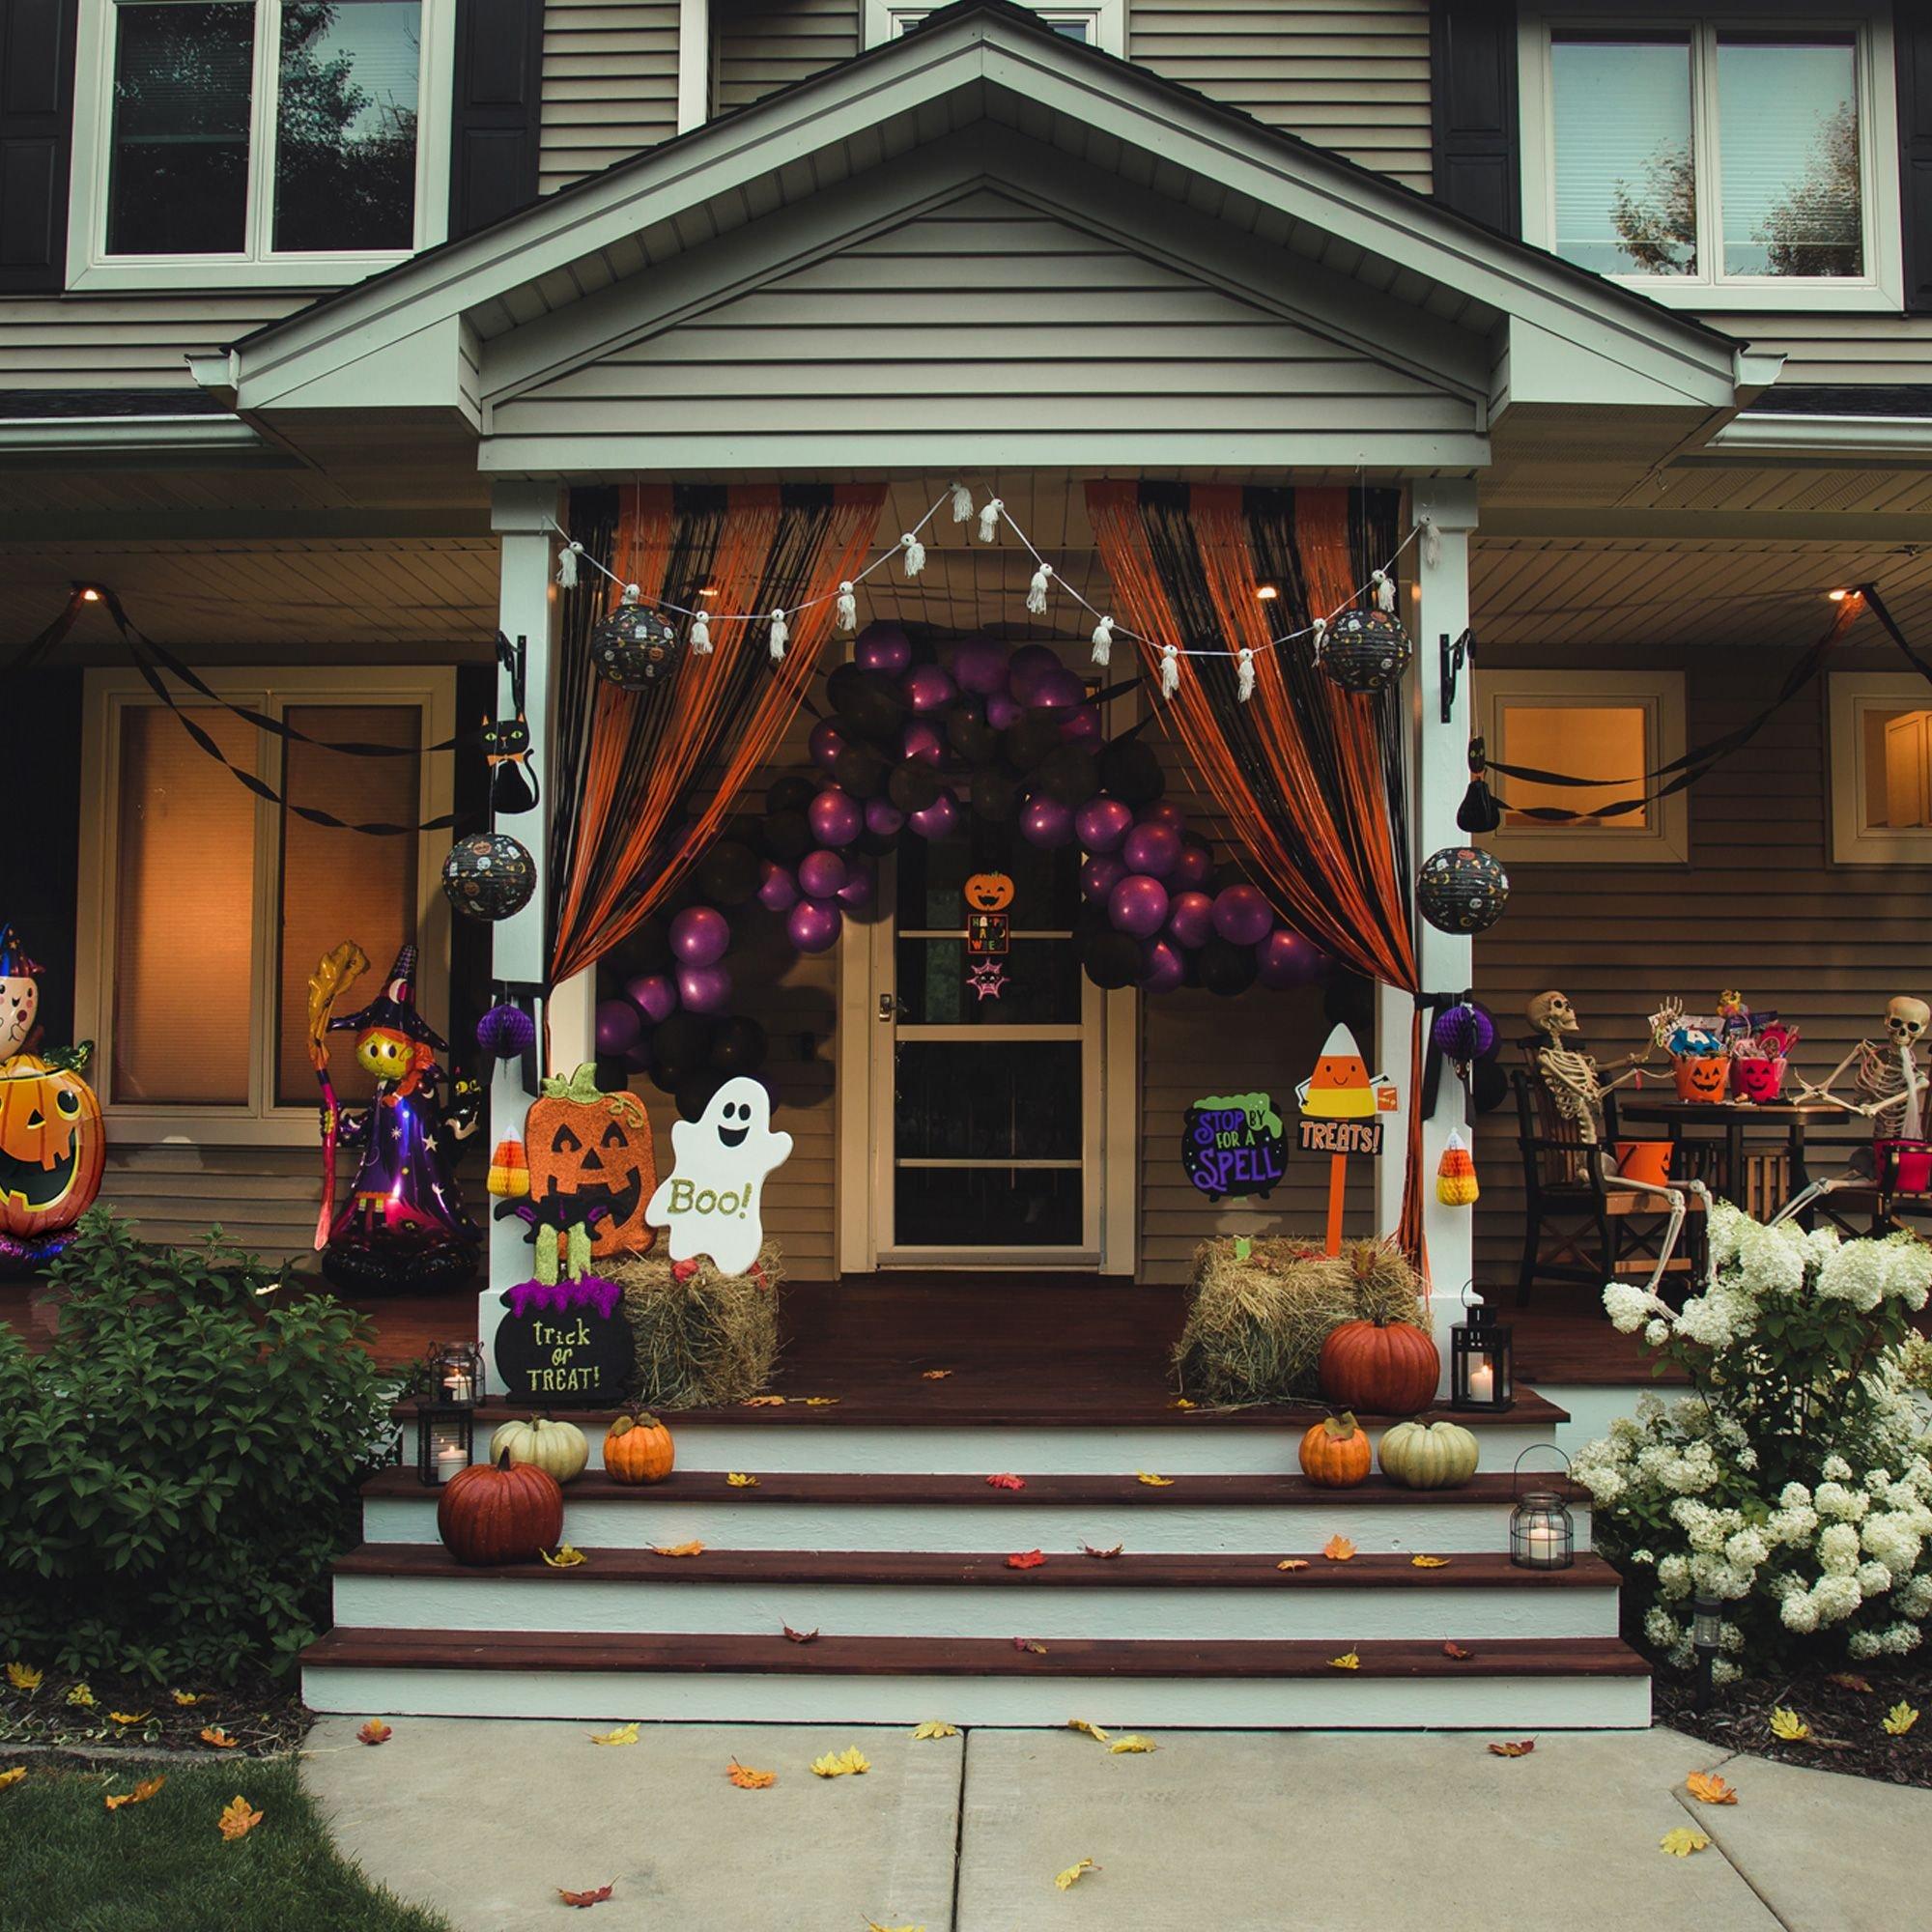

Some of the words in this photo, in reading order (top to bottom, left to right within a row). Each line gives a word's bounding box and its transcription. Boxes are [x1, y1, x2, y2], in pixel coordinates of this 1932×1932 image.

[1194, 1111, 1244, 1144] STOP
[1248, 1109, 1266, 1127] BY
[1215, 1132, 1239, 1150] FOR
[1245, 1129, 1256, 1147] A
[1300, 1121, 1380, 1153] TREATS!
[1193, 1147, 1282, 1192] SPELL
[667, 1179, 753, 1219] Boo!
[532, 1318, 590, 1347] trick
[551, 1347, 573, 1366] or
[526, 1365, 601, 1392] TREAT!
